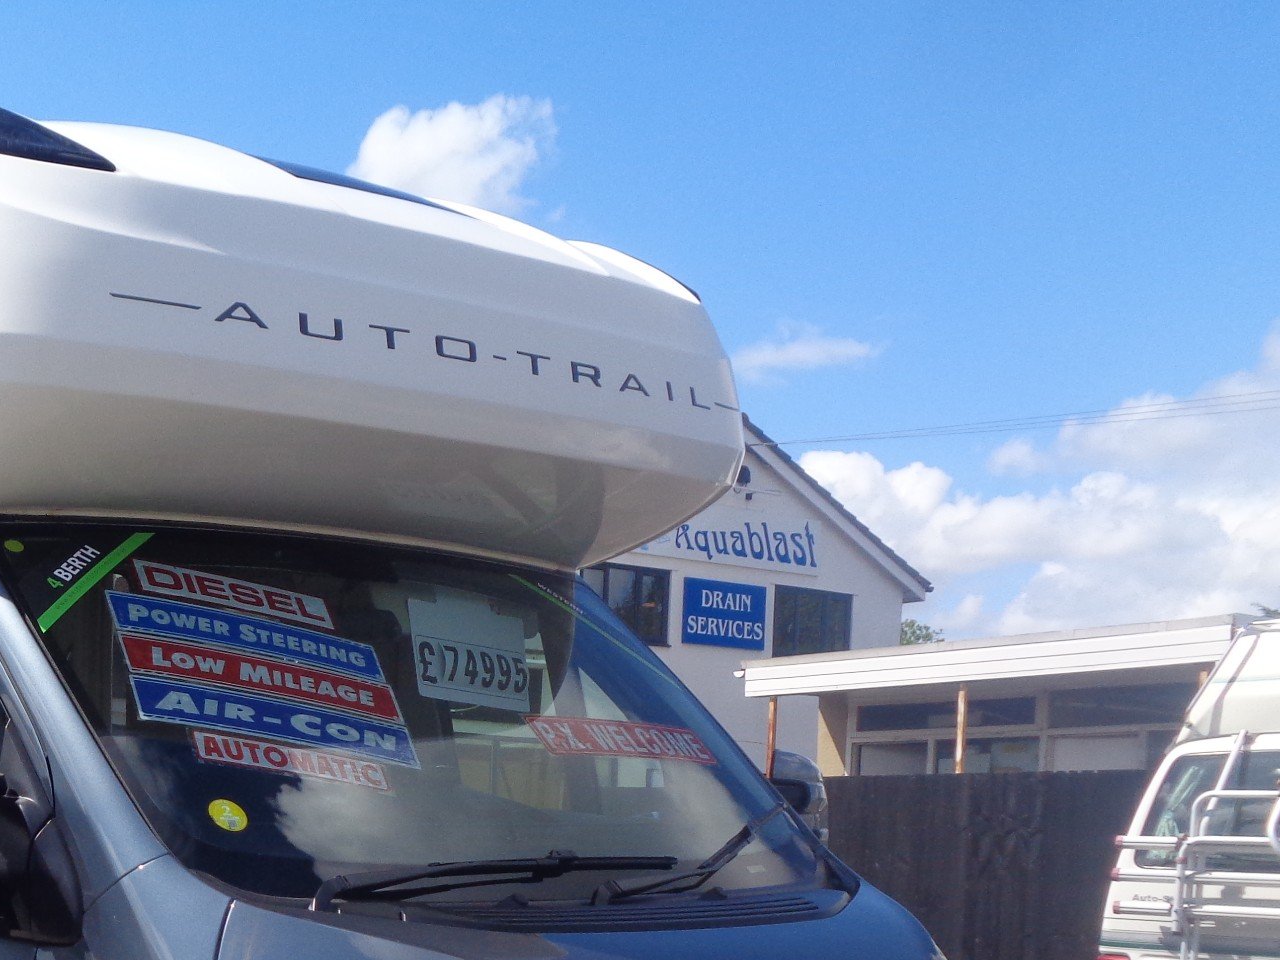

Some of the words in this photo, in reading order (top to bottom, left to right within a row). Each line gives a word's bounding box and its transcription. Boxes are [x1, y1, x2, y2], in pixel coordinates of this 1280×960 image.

[215, 302, 711, 410] AUTO-TRAIL
[53, 544, 101, 582] BERTH
[675, 520, 817, 568] Aquablast
[46, 577, 64, 589] 4
[142, 563, 327, 622] DIESEL
[701, 589, 752, 612] DRAIN
[127, 603, 230, 637] POWER
[239, 623, 367, 667] STEERING
[687, 615, 763, 640] SERVICES
[151, 646, 225, 675] LOW
[239, 661, 375, 707] MILEAGE
[418, 640, 528, 694] £74995
[202, 735, 379, 786] AUTOMATIC
[584, 723, 710, 759] WELCOME
